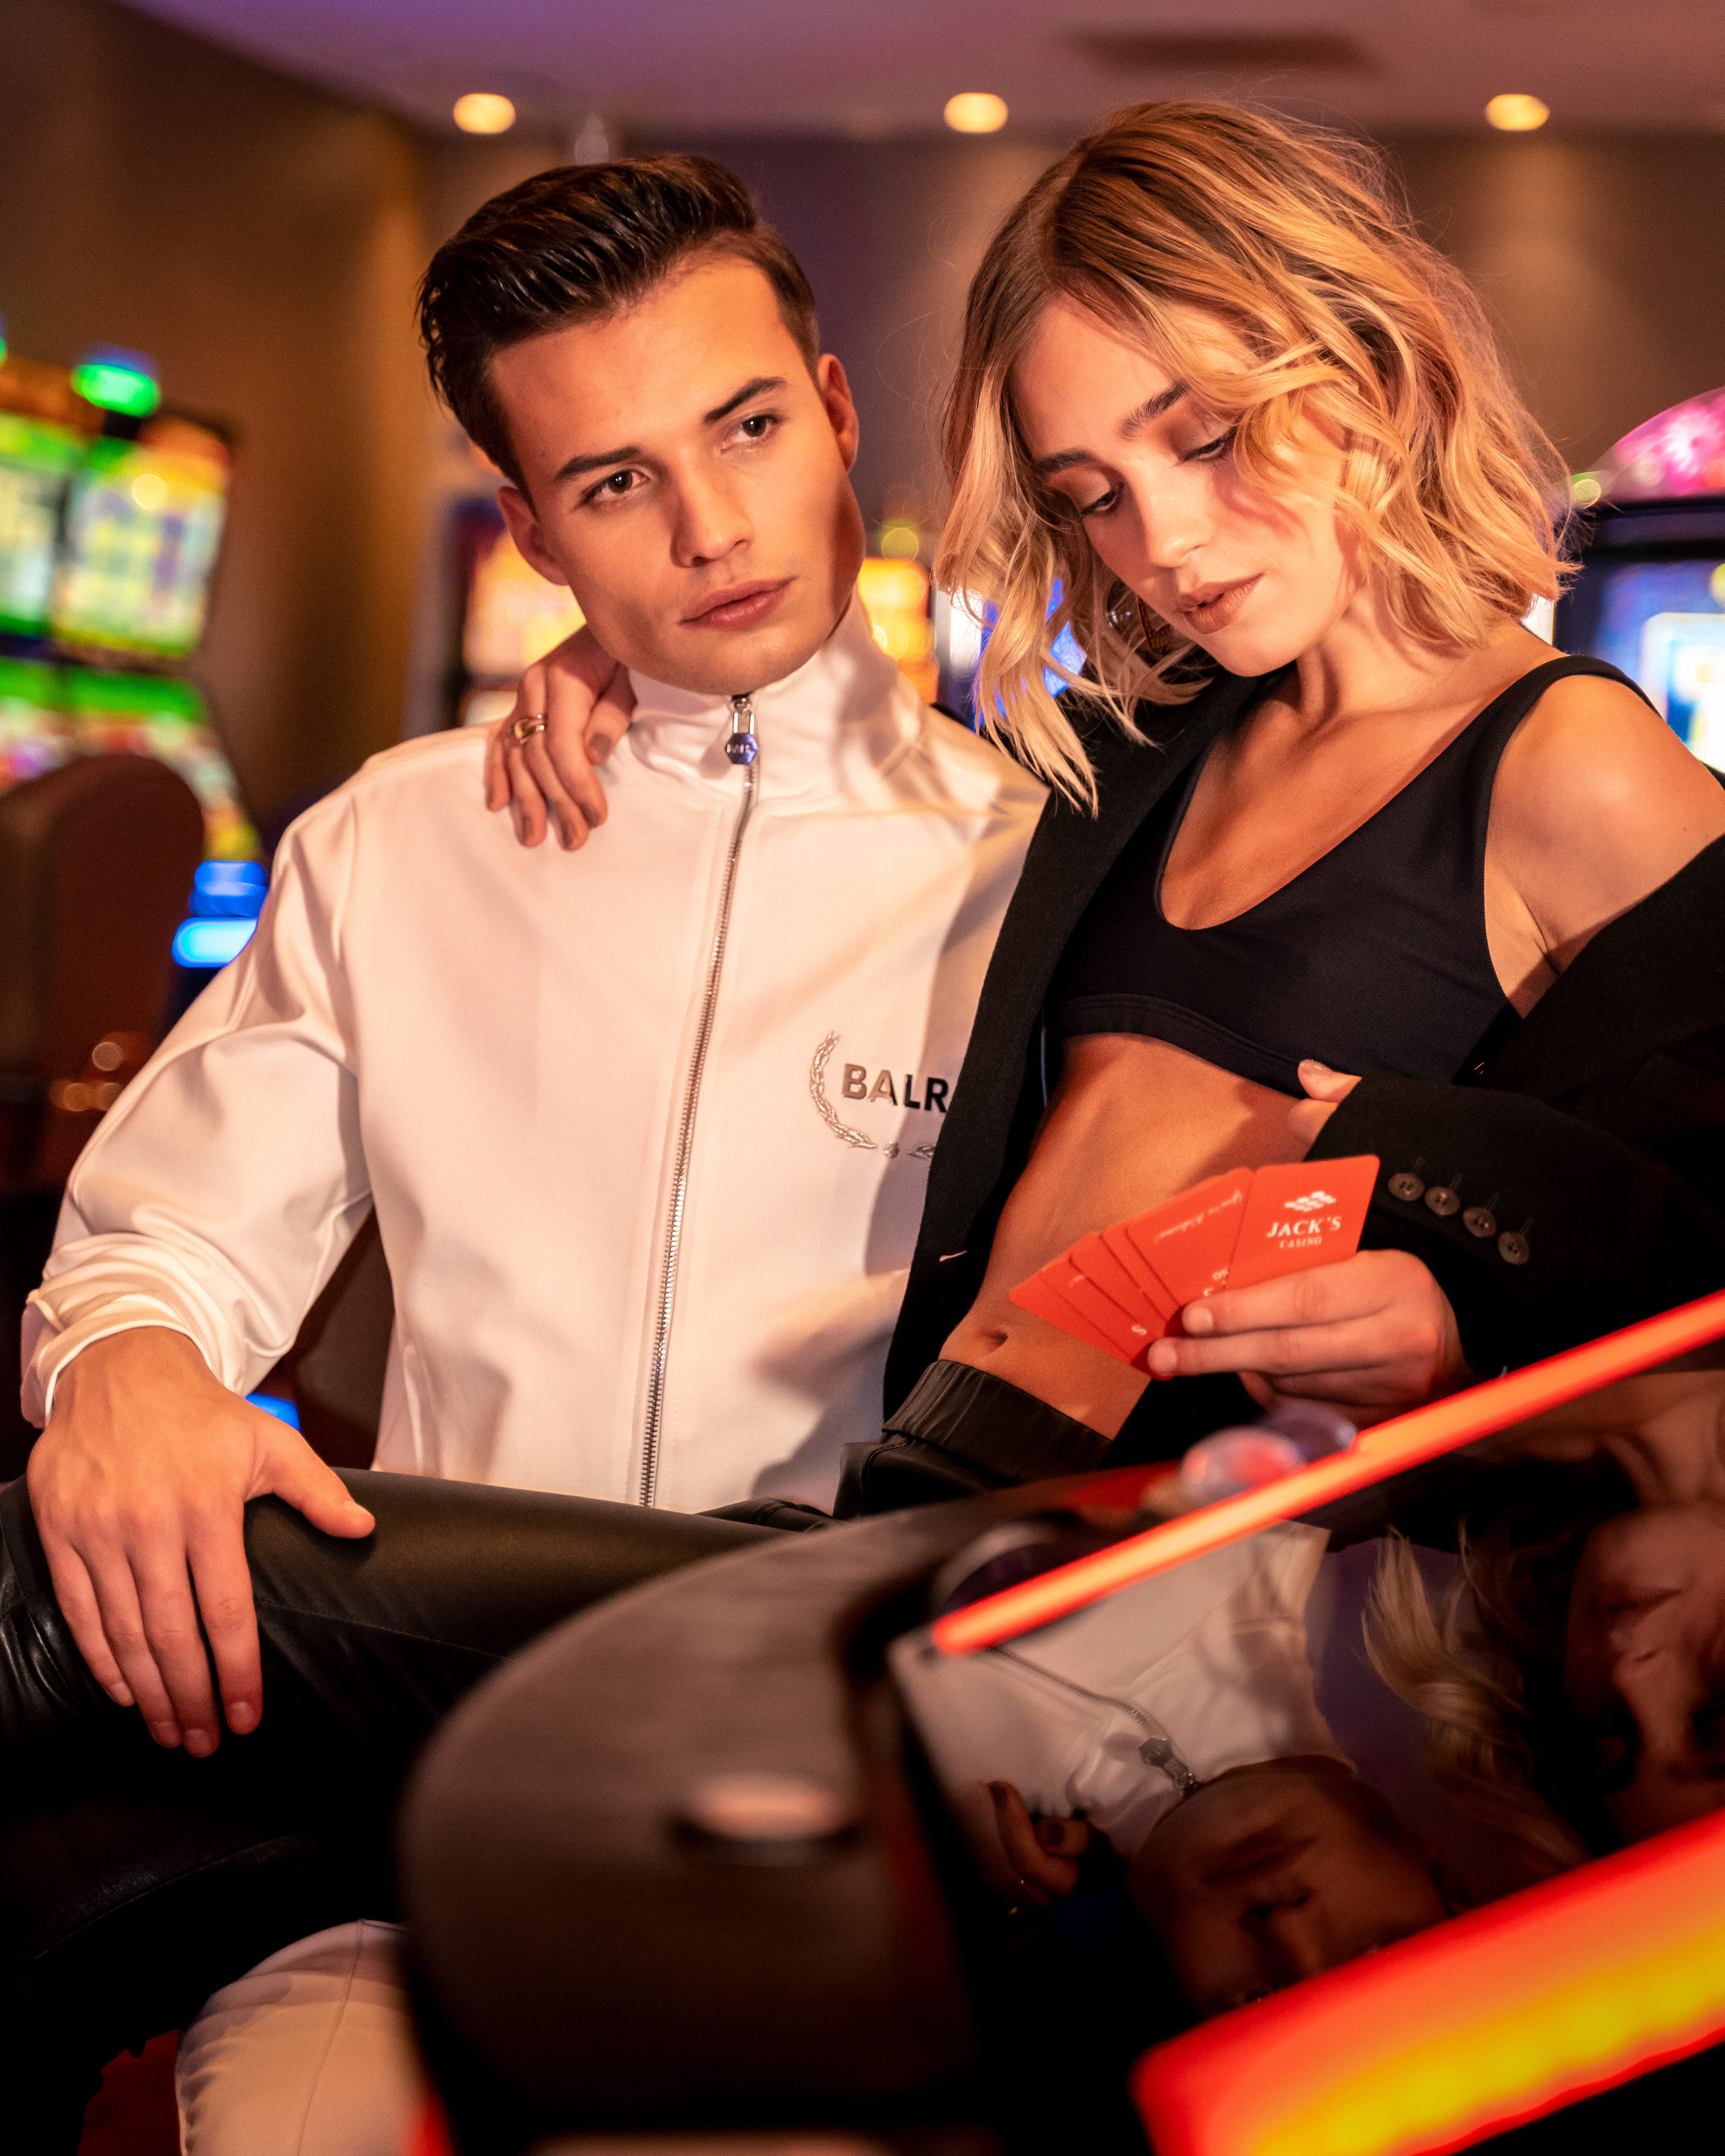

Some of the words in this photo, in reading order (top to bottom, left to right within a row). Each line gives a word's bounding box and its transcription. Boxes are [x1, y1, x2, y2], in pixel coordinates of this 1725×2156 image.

[841, 1063, 949, 1113] BALR
[1267, 1216, 1342, 1238] JACK'S
[1280, 1237, 1322, 1249] CASINO
